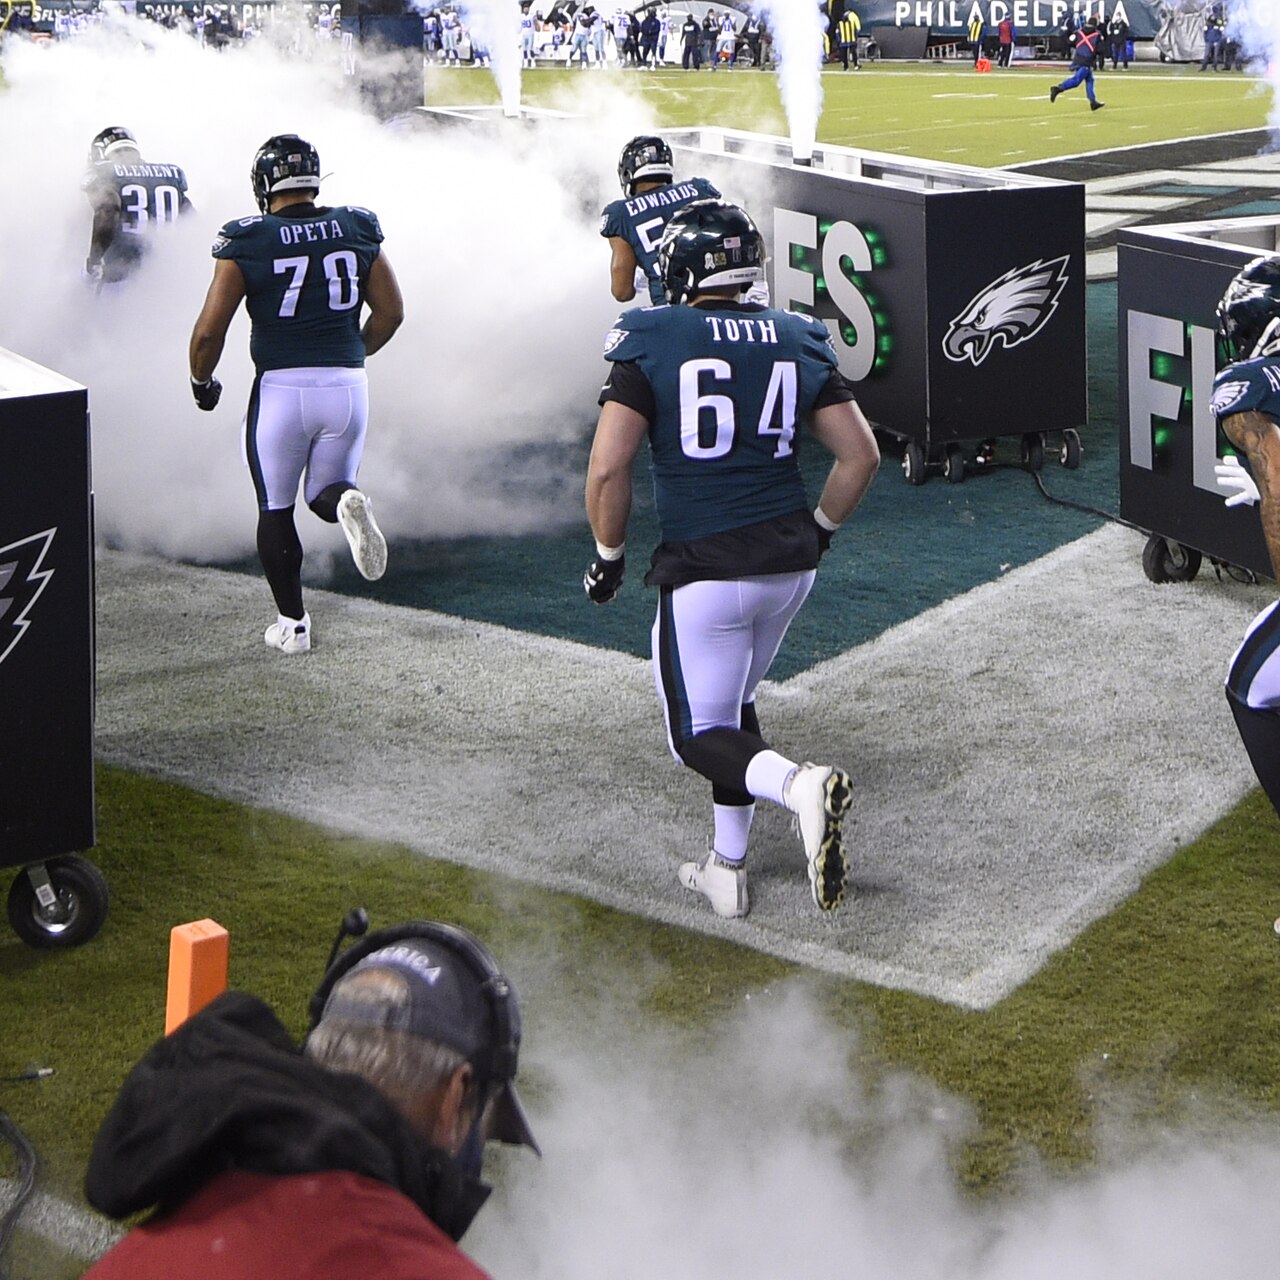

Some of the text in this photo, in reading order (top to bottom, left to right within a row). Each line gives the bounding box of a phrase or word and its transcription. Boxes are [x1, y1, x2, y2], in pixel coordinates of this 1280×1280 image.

[114, 163, 181, 180] CLEMENT
[121, 184, 180, 234] 30
[624, 183, 699, 218] EDWARDS
[279, 219, 344, 246] OPETA
[273, 249, 360, 318] 70
[705, 316, 779, 344] TOTH
[679, 357, 798, 460] 64
[1127, 309, 1257, 499] FL
